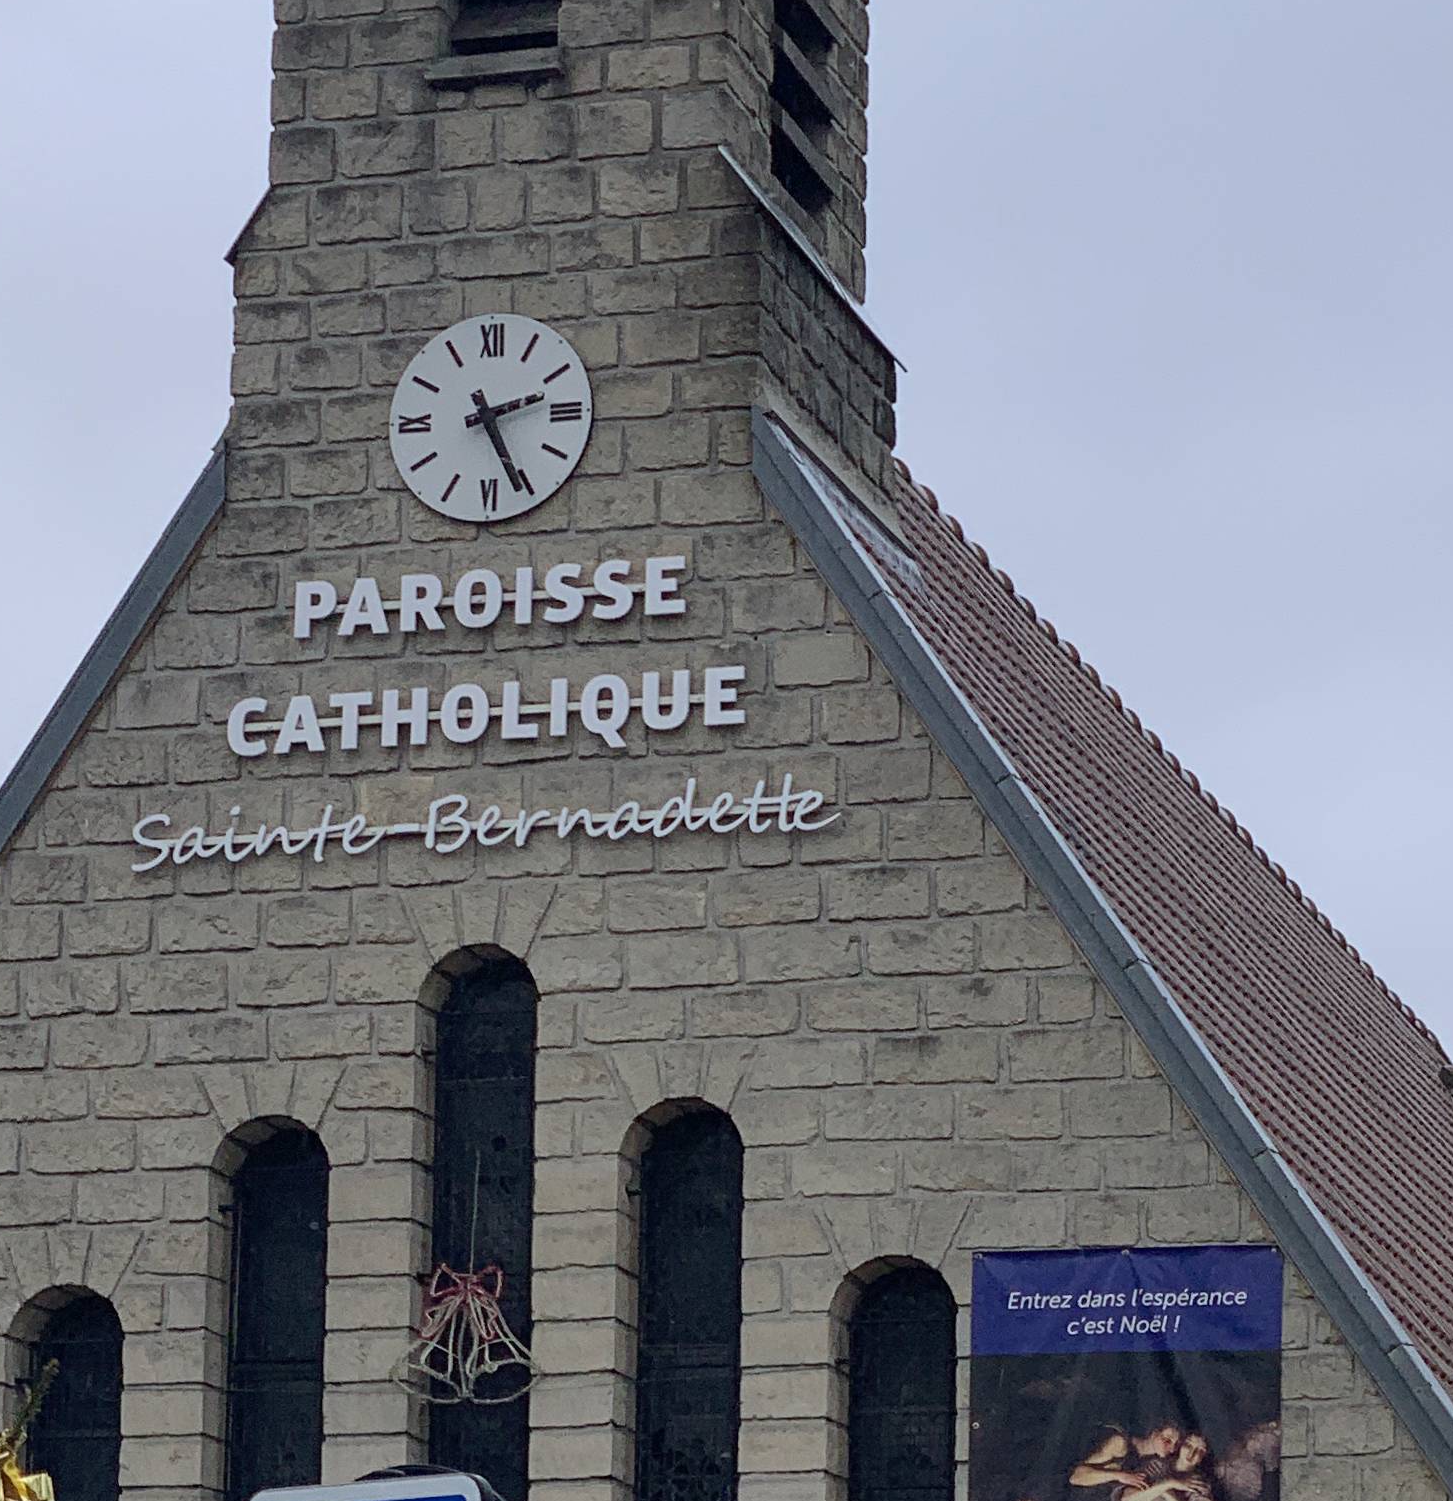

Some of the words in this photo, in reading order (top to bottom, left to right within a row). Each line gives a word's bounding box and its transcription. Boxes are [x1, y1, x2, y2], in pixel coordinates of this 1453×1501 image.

[480, 323, 505, 358] XII
[480, 478, 498, 512] VI
[293, 555, 687, 639] PAROISSE
[227, 665, 747, 757] CATHOLIQUE
[131, 772, 842, 873] Sainte-Bernadette
[1007, 1291, 1073, 1310] Entrez
[1077, 1290, 1126, 1308] dans
[1130, 1287, 1248, 1310] l'espérance
[1066, 1316, 1114, 1335] c'est
[1119, 1315, 1168, 1334] Noël
